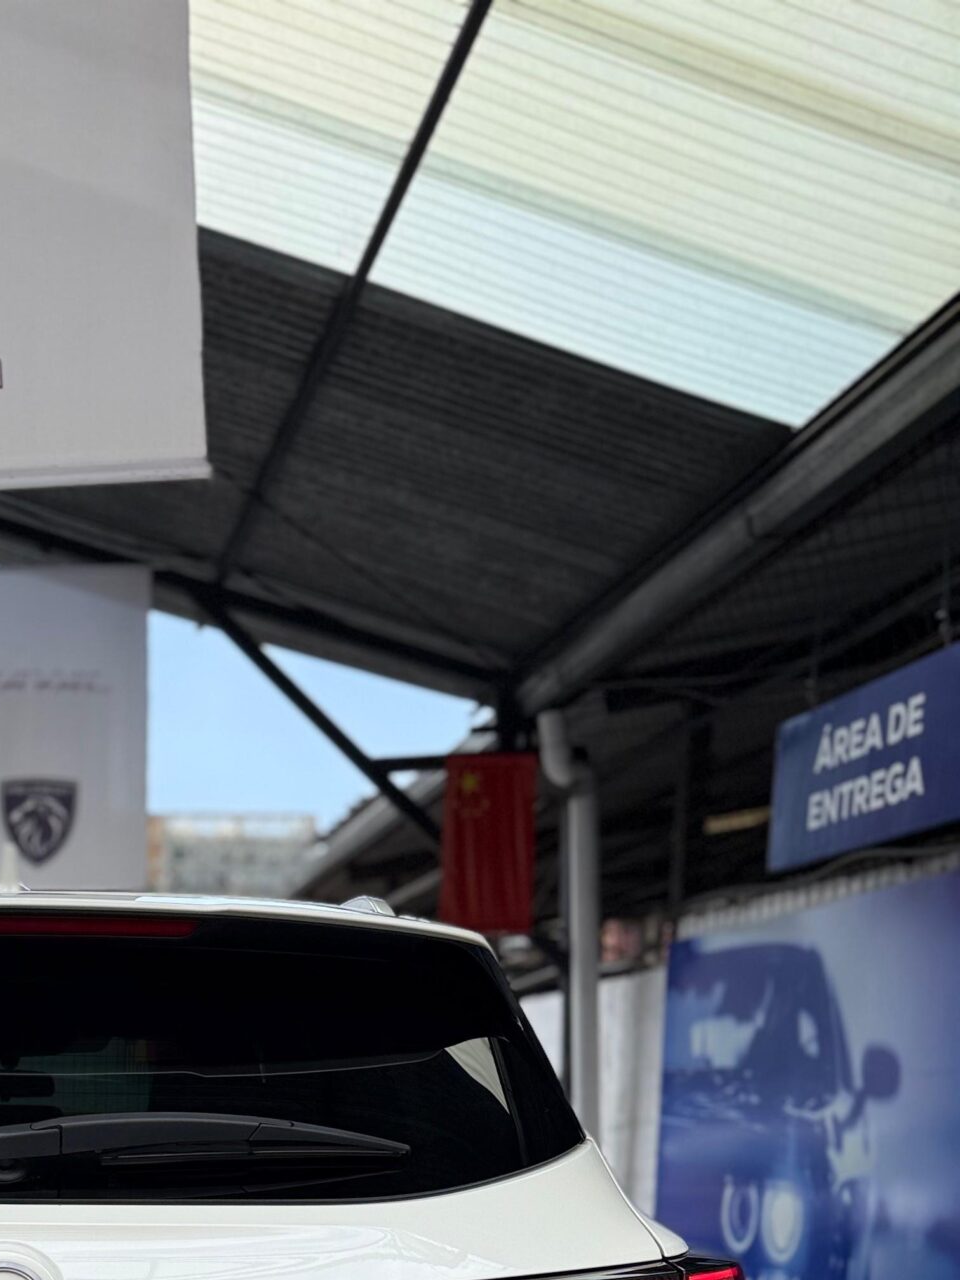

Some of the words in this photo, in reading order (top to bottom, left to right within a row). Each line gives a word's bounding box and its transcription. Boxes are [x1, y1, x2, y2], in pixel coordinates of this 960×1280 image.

[813, 711, 883, 774] ÁREA
[886, 692, 926, 746] DE
[806, 755, 925, 832] ENTREGA
